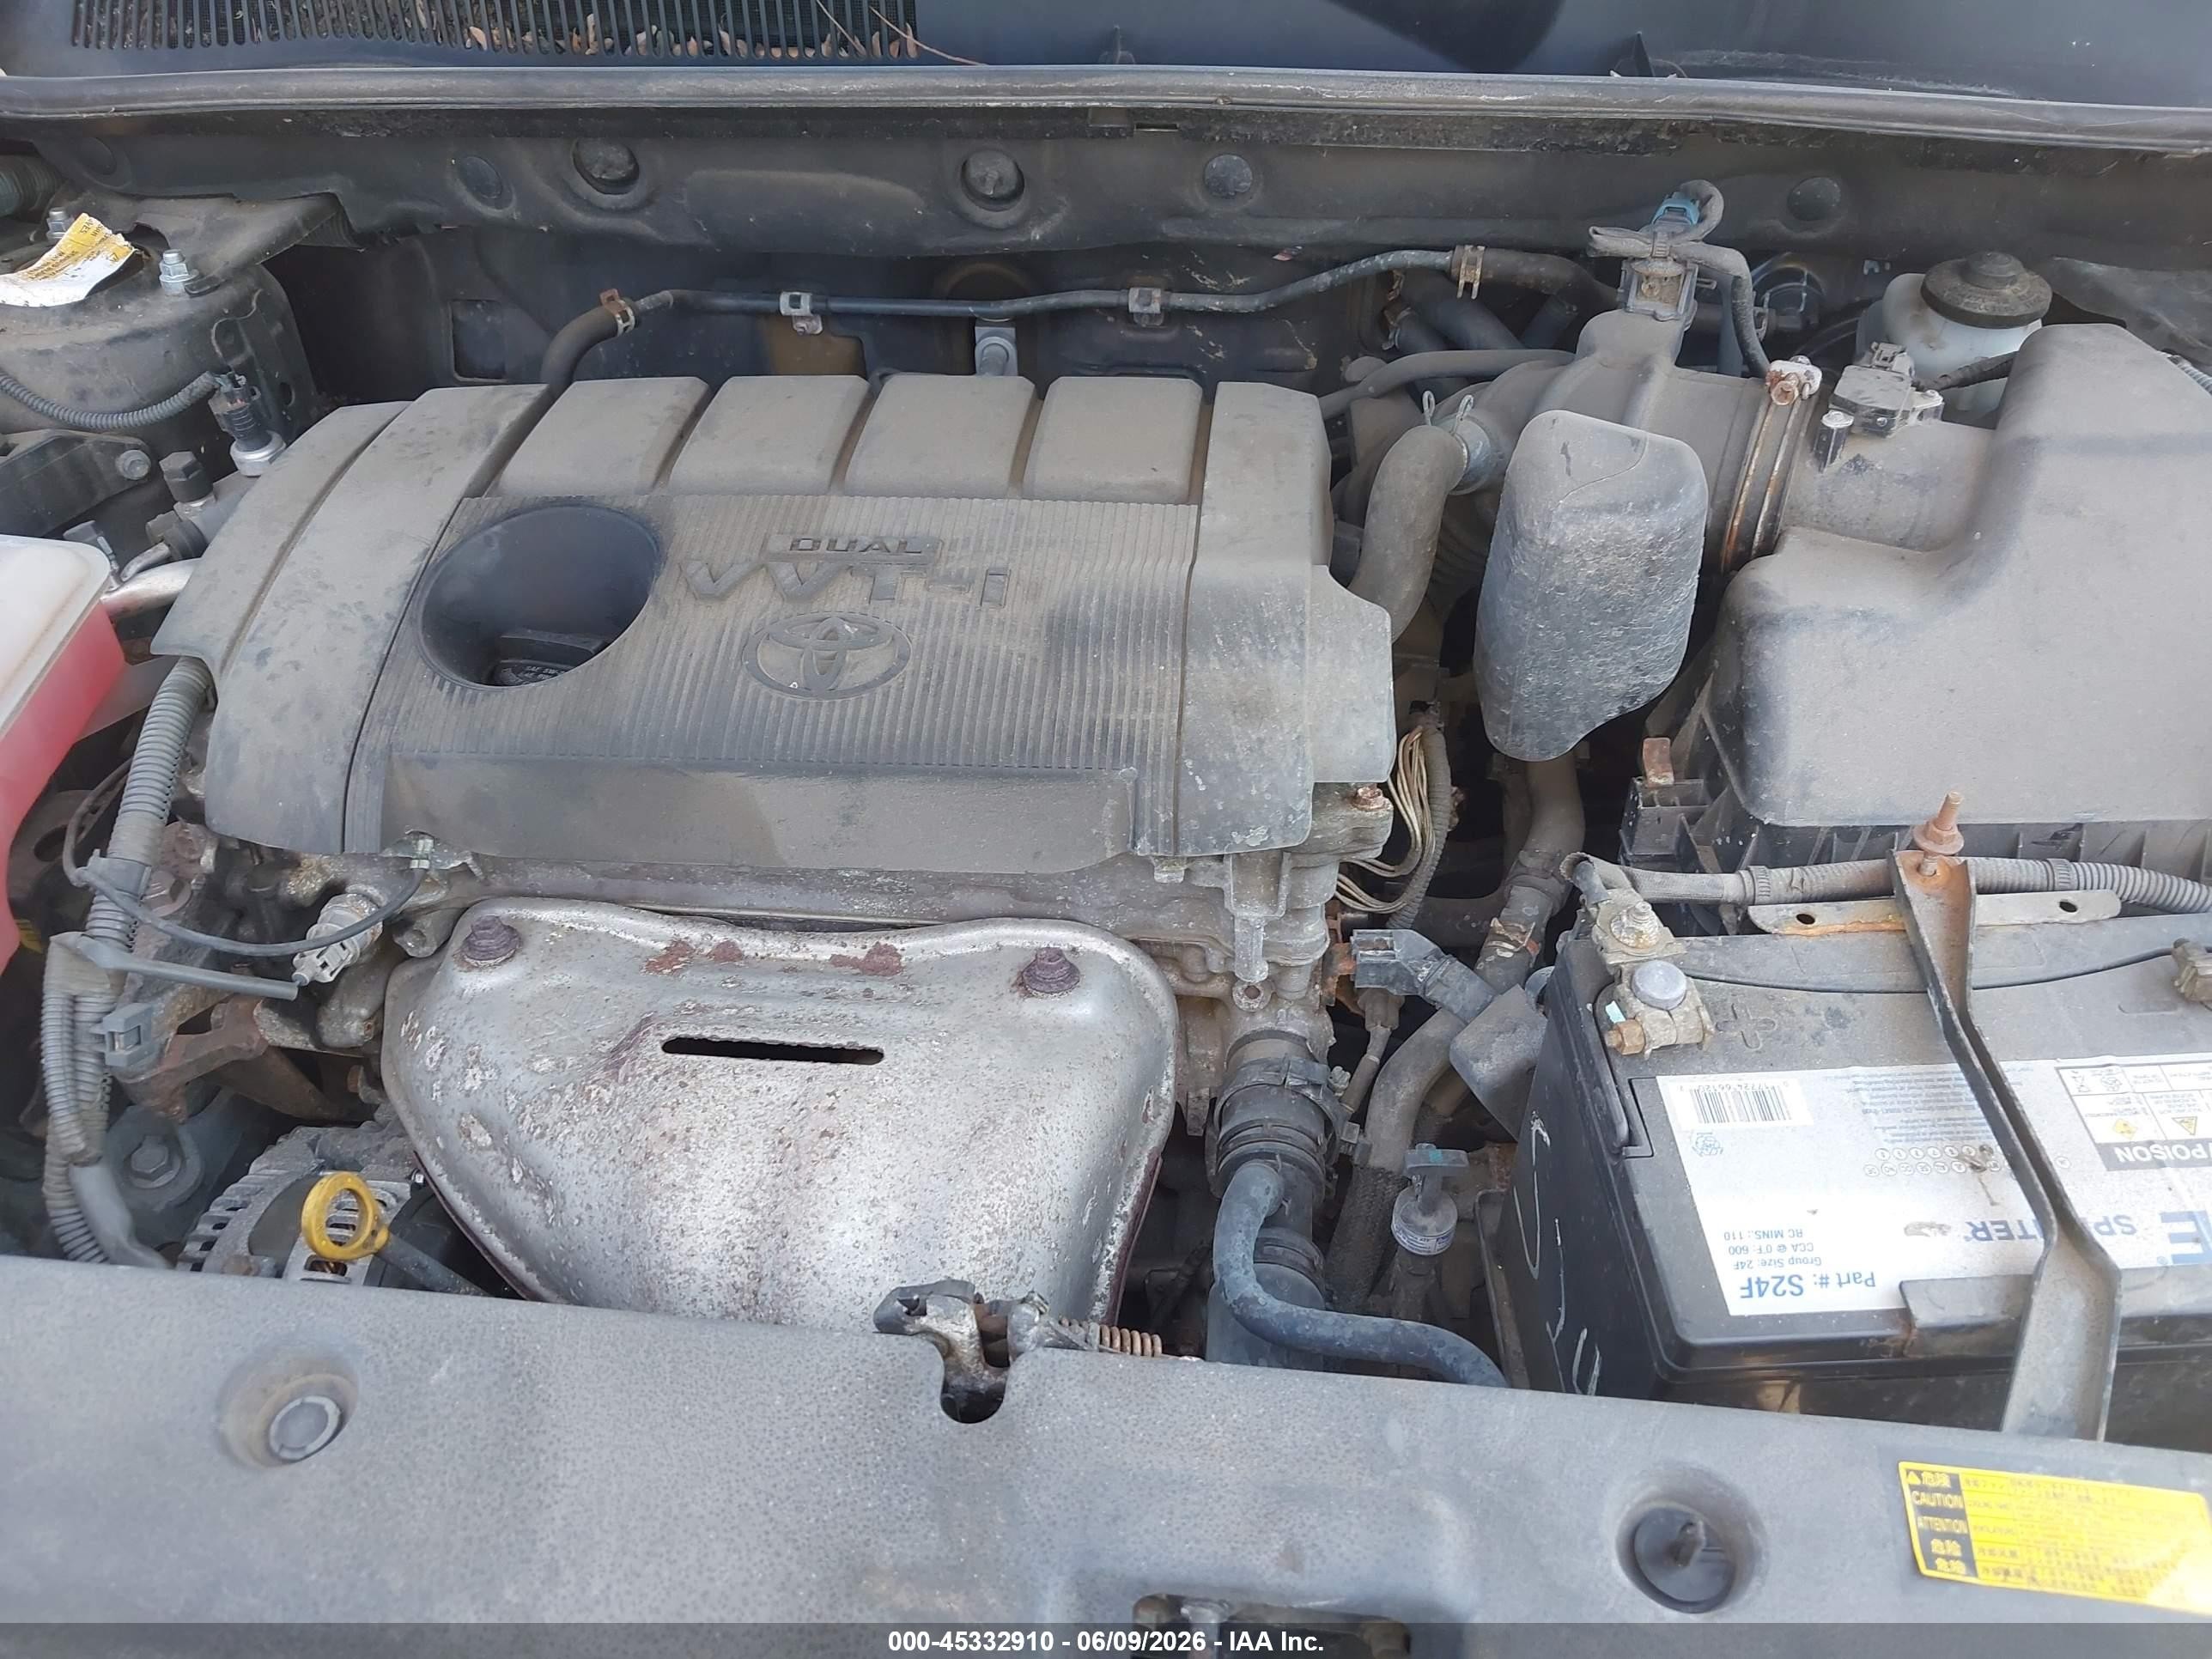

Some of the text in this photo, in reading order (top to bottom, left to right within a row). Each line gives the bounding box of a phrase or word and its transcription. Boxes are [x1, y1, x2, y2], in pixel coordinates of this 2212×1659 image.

[788, 537, 922, 554] DUAL
[1723, 1231, 1743, 1241] 110
[1789, 1228, 1803, 1238] RC
[1728, 1245, 1749, 1255] 600
[1777, 1243, 1787, 1254] @
[1791, 1242, 1814, 1253] CCA
[1733, 1256, 1822, 1270] Group Size: 24F
[1740, 1271, 1876, 1298] Part #: S24F
[1911, 1490, 1964, 1509] CAUTION
